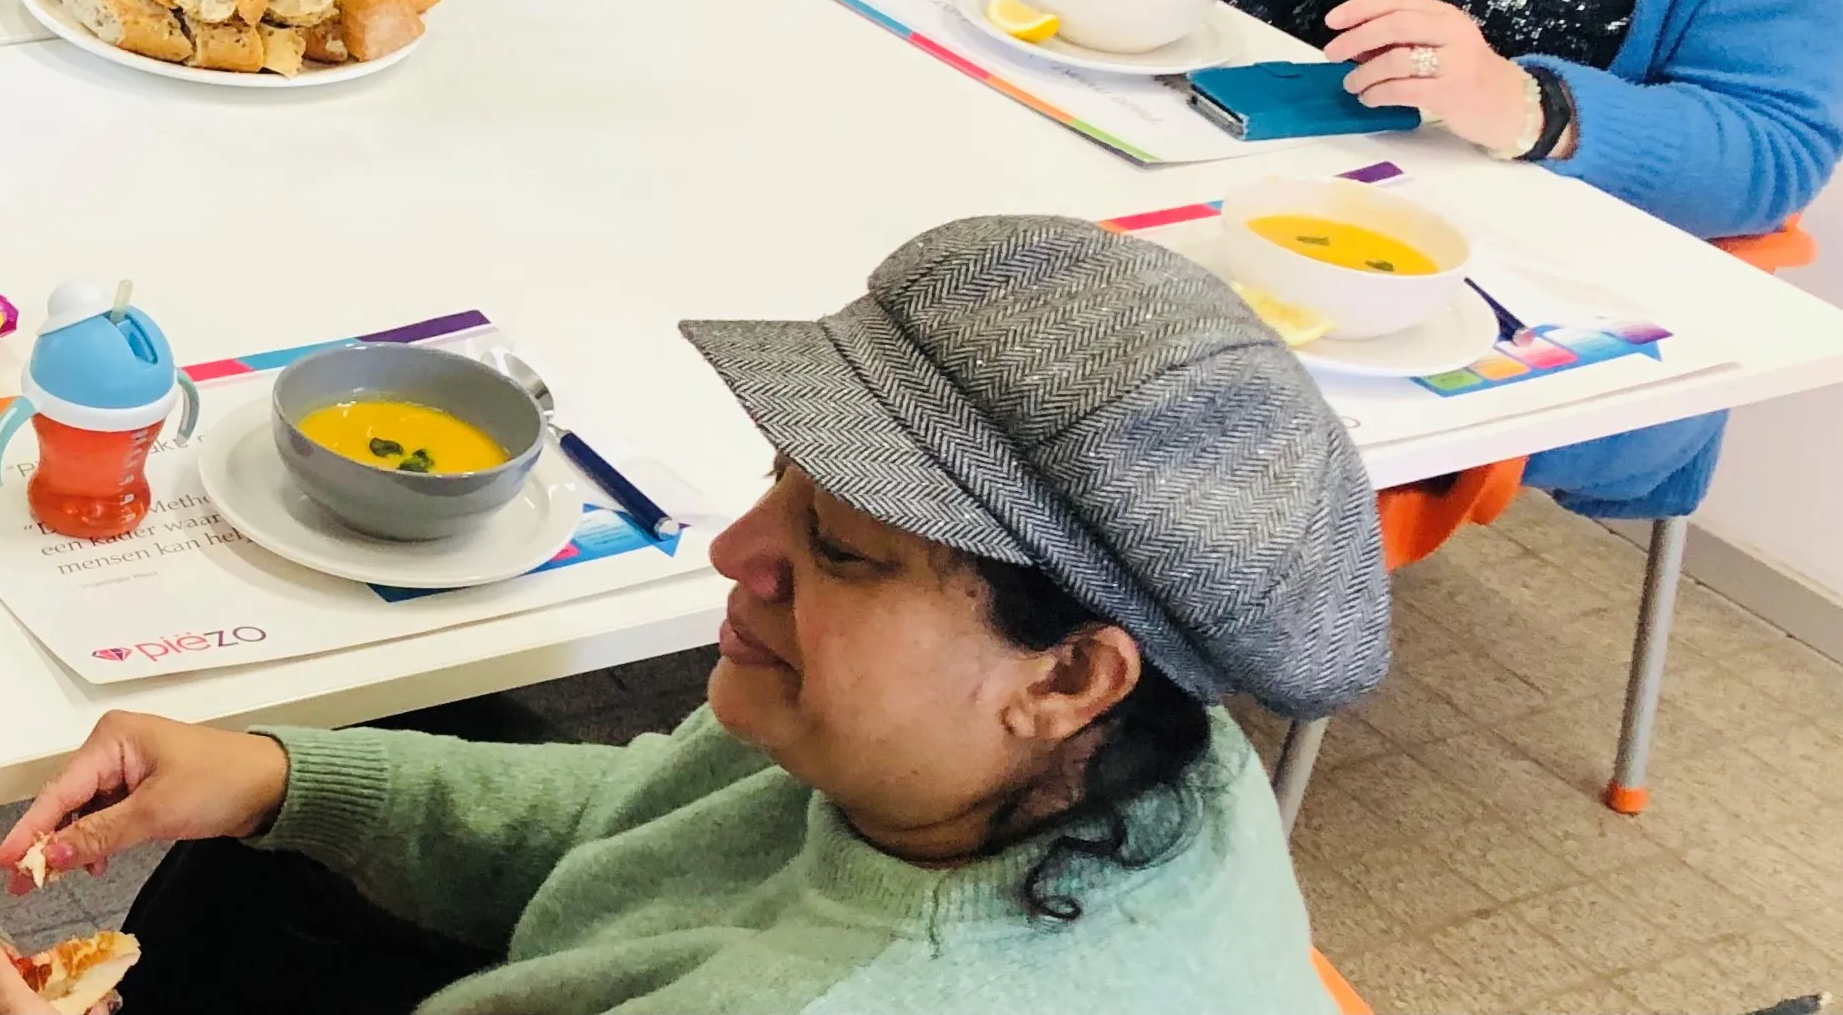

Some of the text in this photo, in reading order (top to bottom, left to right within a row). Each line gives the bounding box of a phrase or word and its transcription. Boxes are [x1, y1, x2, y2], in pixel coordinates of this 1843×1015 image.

[41, 539, 82, 557] een
[164, 513, 220, 532] waar
[57, 548, 150, 575] mensen
[154, 539, 201, 557] kan
[134, 626, 267, 662] piëzo
